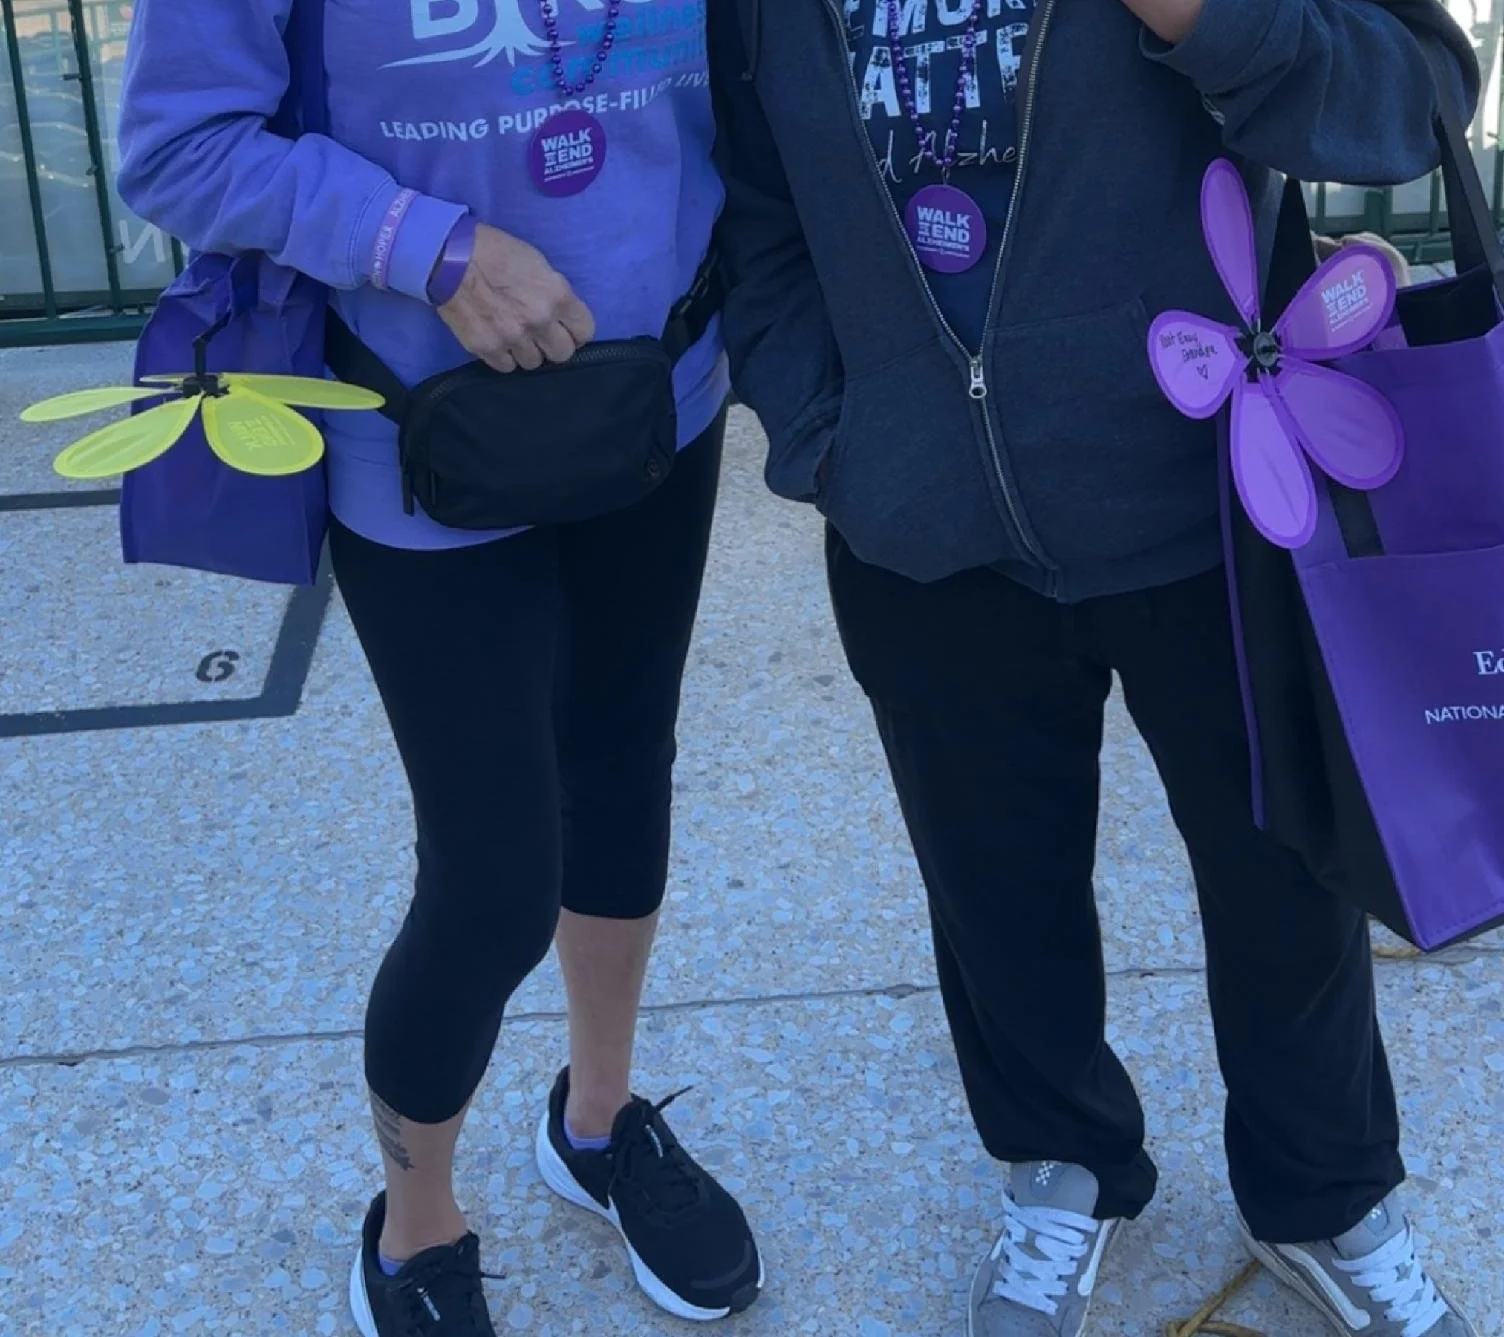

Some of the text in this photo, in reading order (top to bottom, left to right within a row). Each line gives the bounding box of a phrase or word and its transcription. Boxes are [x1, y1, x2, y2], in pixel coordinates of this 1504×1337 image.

[850, 22, 1029, 120] ATTE
[379, 118, 489, 143] LEADING
[541, 127, 593, 152] WALK
[558, 143, 594, 163] END
[917, 205, 972, 229] WALK
[931, 224, 970, 244] END
[1321, 269, 1365, 304] WALK
[1337, 284, 1367, 311] END
[196, 650, 241, 682] 6
